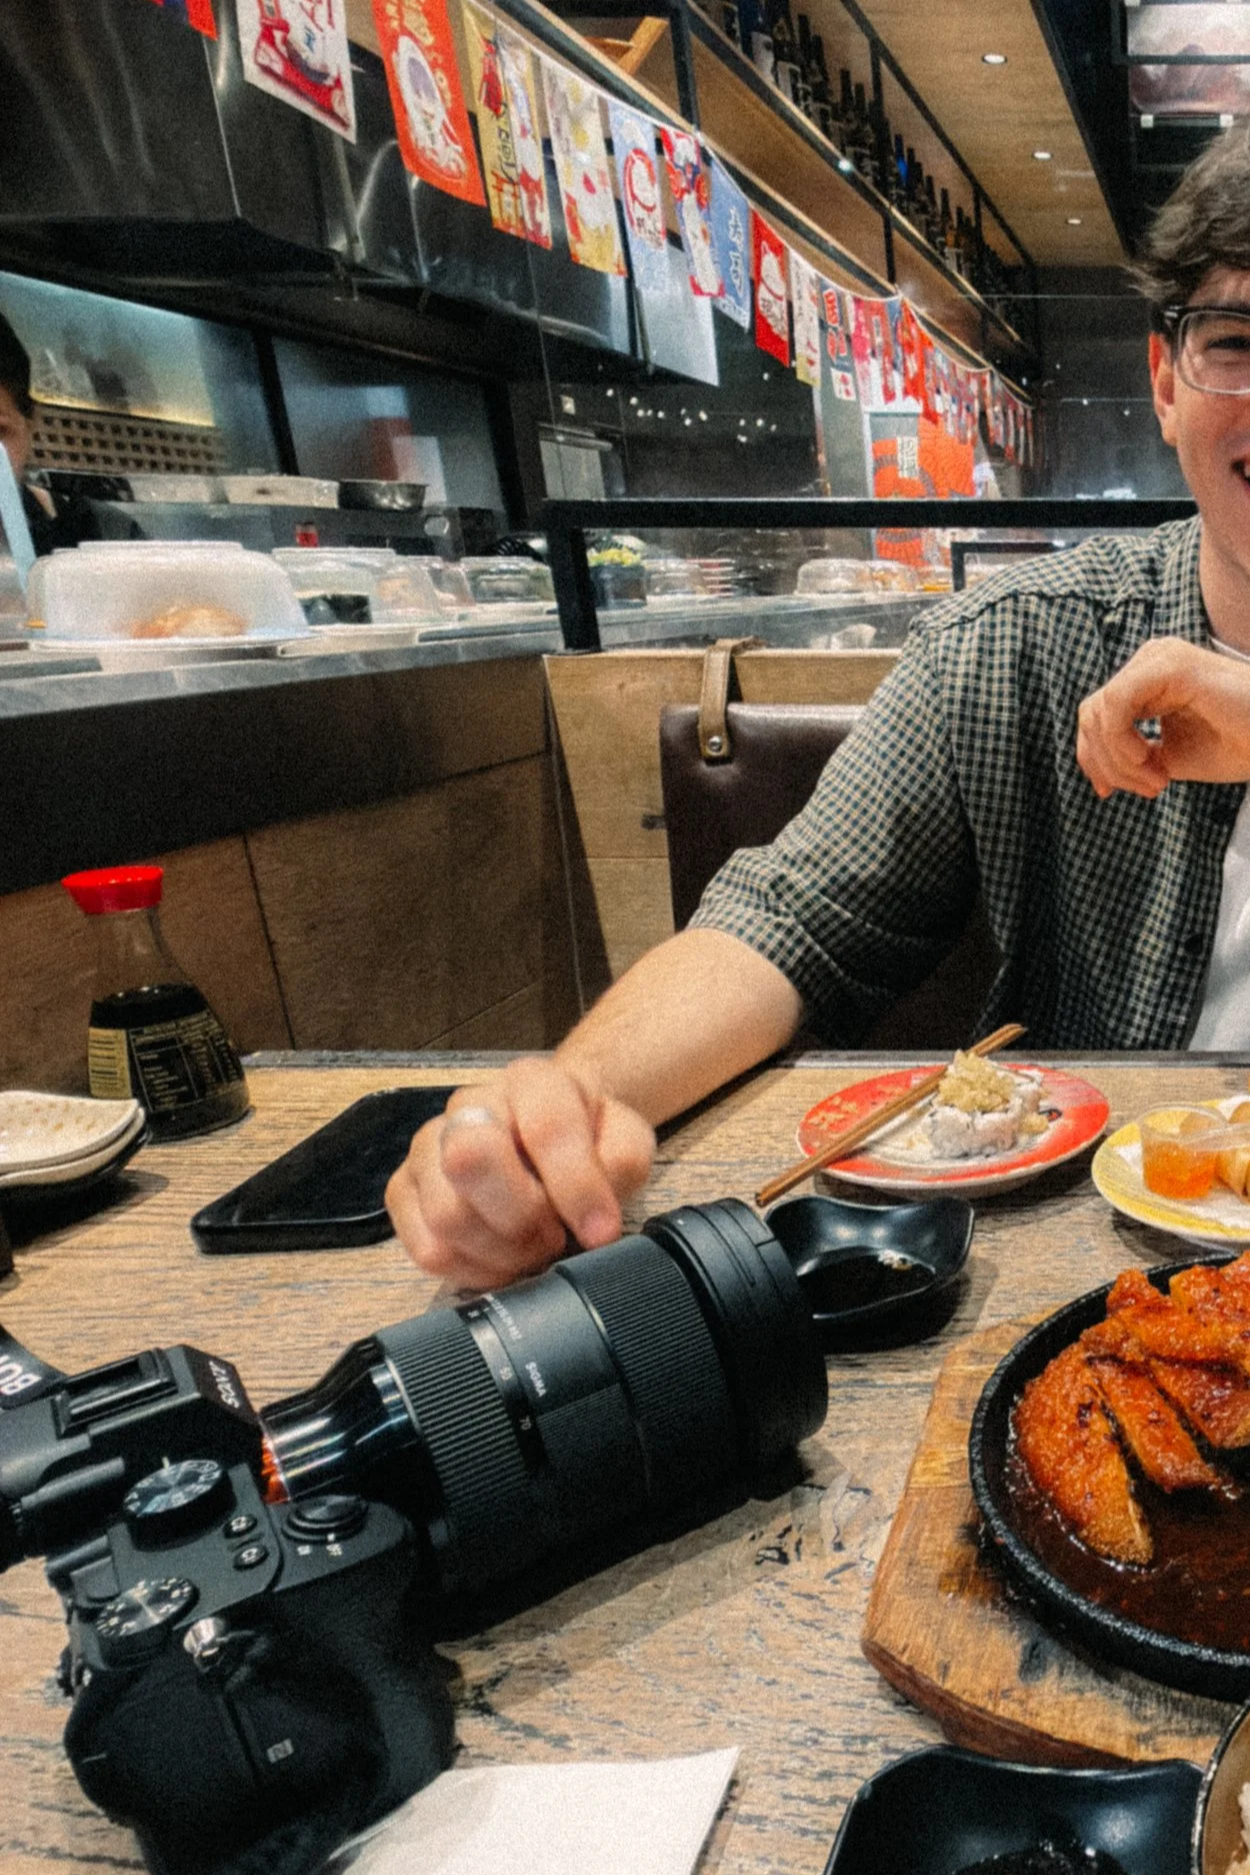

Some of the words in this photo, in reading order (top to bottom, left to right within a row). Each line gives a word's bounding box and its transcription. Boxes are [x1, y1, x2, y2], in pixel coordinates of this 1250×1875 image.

[208, 1359, 241, 1409] SONY
[499, 1366, 513, 1381] 50
[525, 1361, 547, 1398] SIGMA
[519, 1416, 532, 1431] 70
